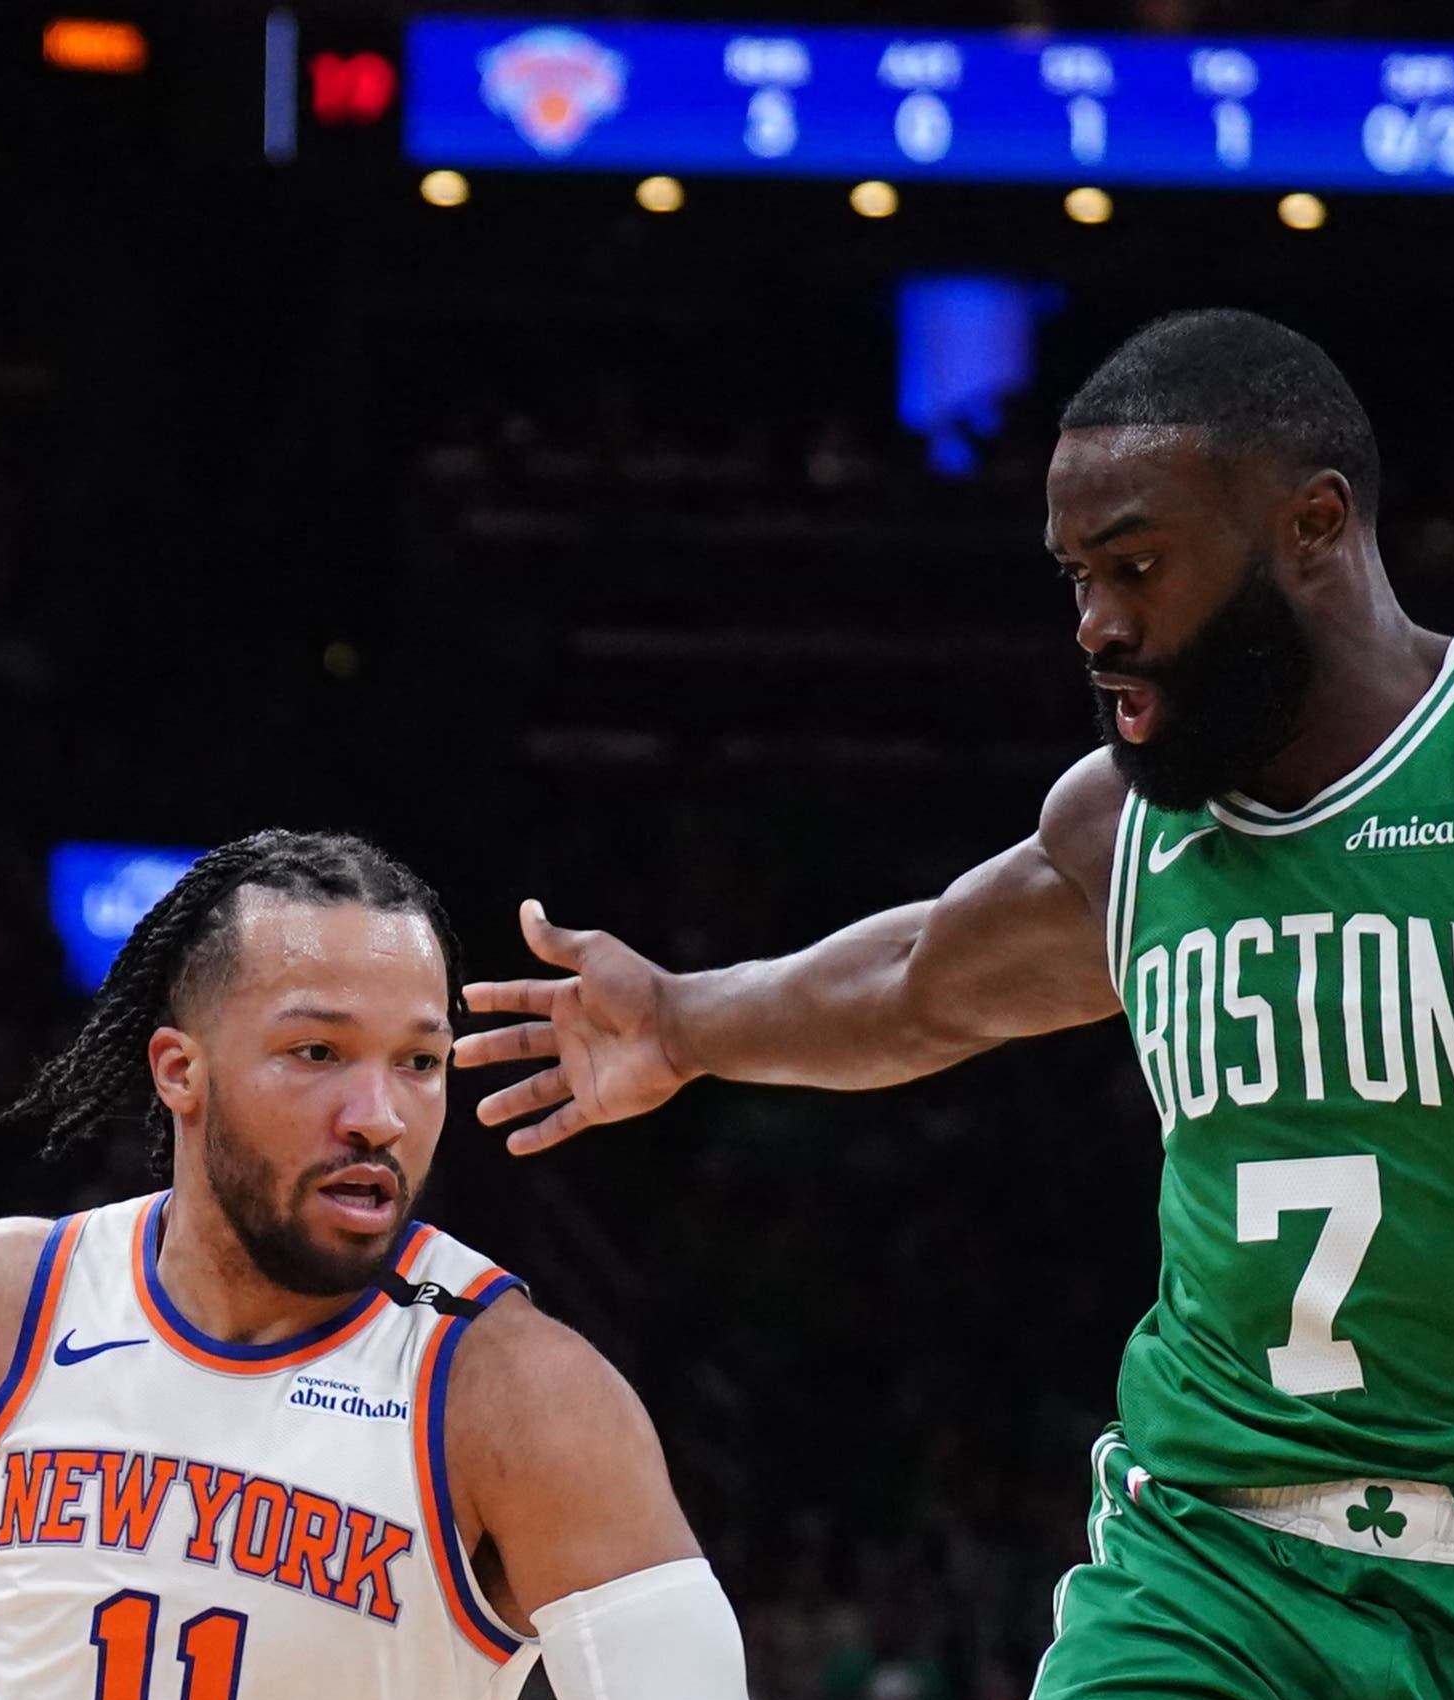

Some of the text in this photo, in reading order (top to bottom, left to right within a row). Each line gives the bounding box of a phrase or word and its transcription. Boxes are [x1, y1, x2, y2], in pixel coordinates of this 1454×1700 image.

[1236, 1154, 1383, 1397] 7
[290, 1387, 410, 1420] abu dhabi
[297, 1375, 361, 1394] experience
[184, 1460, 418, 1627] YORK
